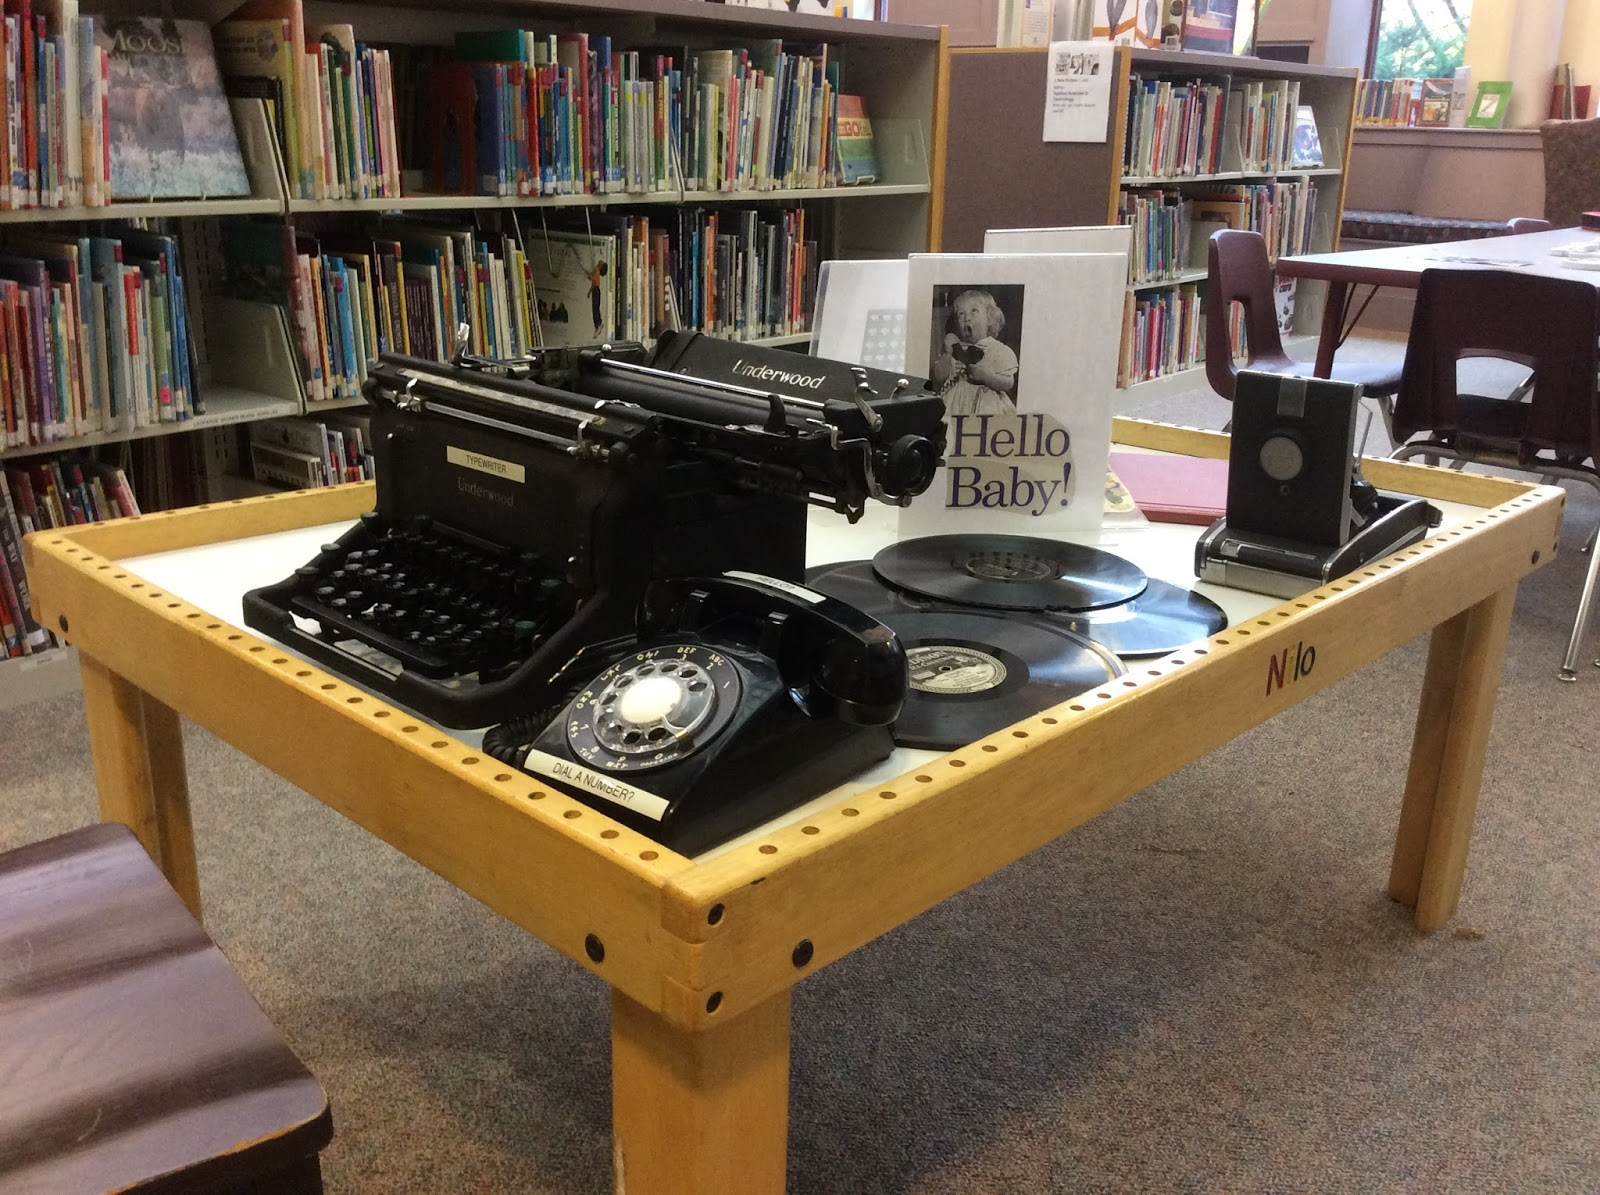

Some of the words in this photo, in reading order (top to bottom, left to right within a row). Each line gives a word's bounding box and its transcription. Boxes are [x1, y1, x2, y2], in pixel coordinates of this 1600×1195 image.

[732, 359, 826, 390] Underwood
[949, 413, 1071, 458] Hello
[466, 454, 507, 474] TYPEWRITER
[458, 476, 514, 507] Underwood
[946, 462, 1072, 517] Baby!
[676, 646, 697, 654] DEF
[708, 653, 725, 666] ABC
[706, 662, 714, 670] 2
[552, 762, 573, 781] DIAL
[574, 771, 582, 782] A
[583, 773, 635, 802] NUMBER?
